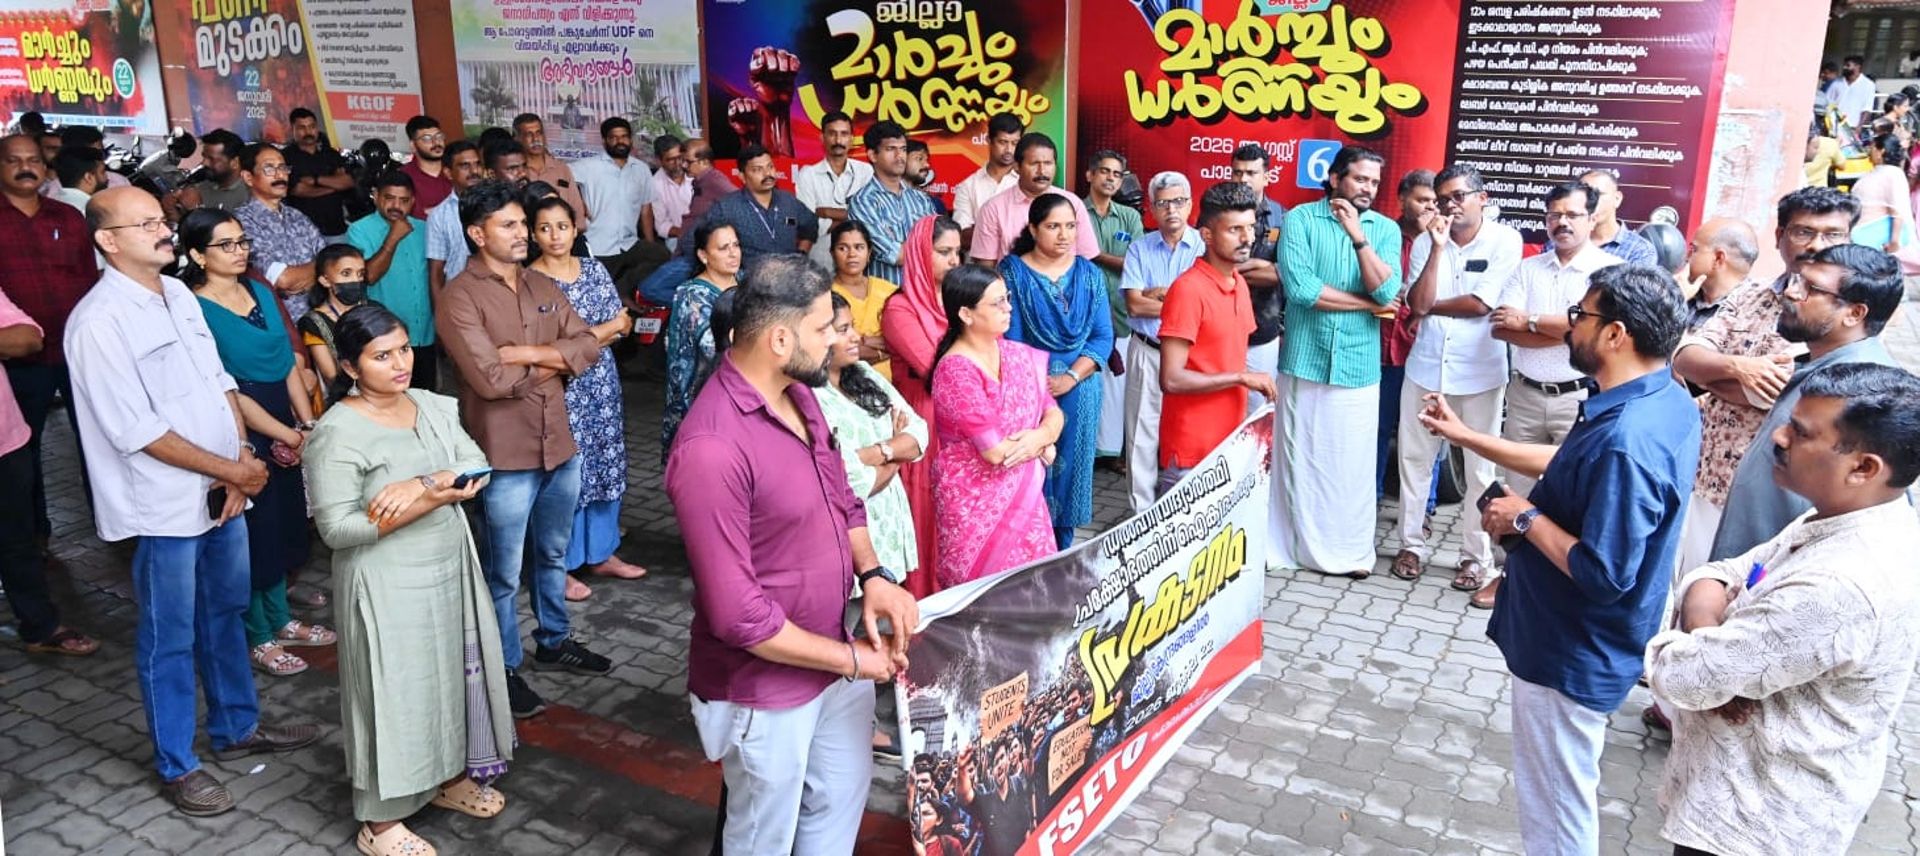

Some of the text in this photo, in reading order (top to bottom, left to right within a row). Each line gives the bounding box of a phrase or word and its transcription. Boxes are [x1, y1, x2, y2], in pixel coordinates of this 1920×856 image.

[876, 0, 962, 29] ജില്ലാ
[1572, 5, 1594, 19] ഉടൻ
[21, 25, 92, 66] മാർച്ചും
[612, 26, 636, 37] UDF
[826, 9, 1016, 86] മാർച്ചും
[1551, 42, 1580, 55] നിയമം
[245, 70, 260, 86] 22
[1464, 59, 1486, 69] പഴയ
[1487, 57, 1528, 70] പെൻഷൻ
[25, 62, 112, 103] ധർണ്ണയും
[1124, 57, 1421, 134] ധർണ്ണയും
[347, 95, 395, 111] KGOF
[1460, 99, 1599, 116] ലേബർ കോഡുകൾ പിൻവലിക്കുക
[1190, 136, 1234, 154] 2026
[1589, 145, 1619, 157] നടപടി
[1619, 146, 1684, 163] പിൻവലിക്കുക
[1307, 147, 1330, 184] 6
[1079, 522, 1247, 727] പ്രകടനം
[984, 680, 1027, 711] STUDENTS
[987, 699, 1017, 731] UNITE
[1125, 696, 1163, 733] 2026
[1053, 722, 1090, 755] EDUCATION
[1062, 742, 1077, 760] NOT
[1051, 750, 1086, 784] FOR SALE
[1037, 730, 1150, 856] FSETO
